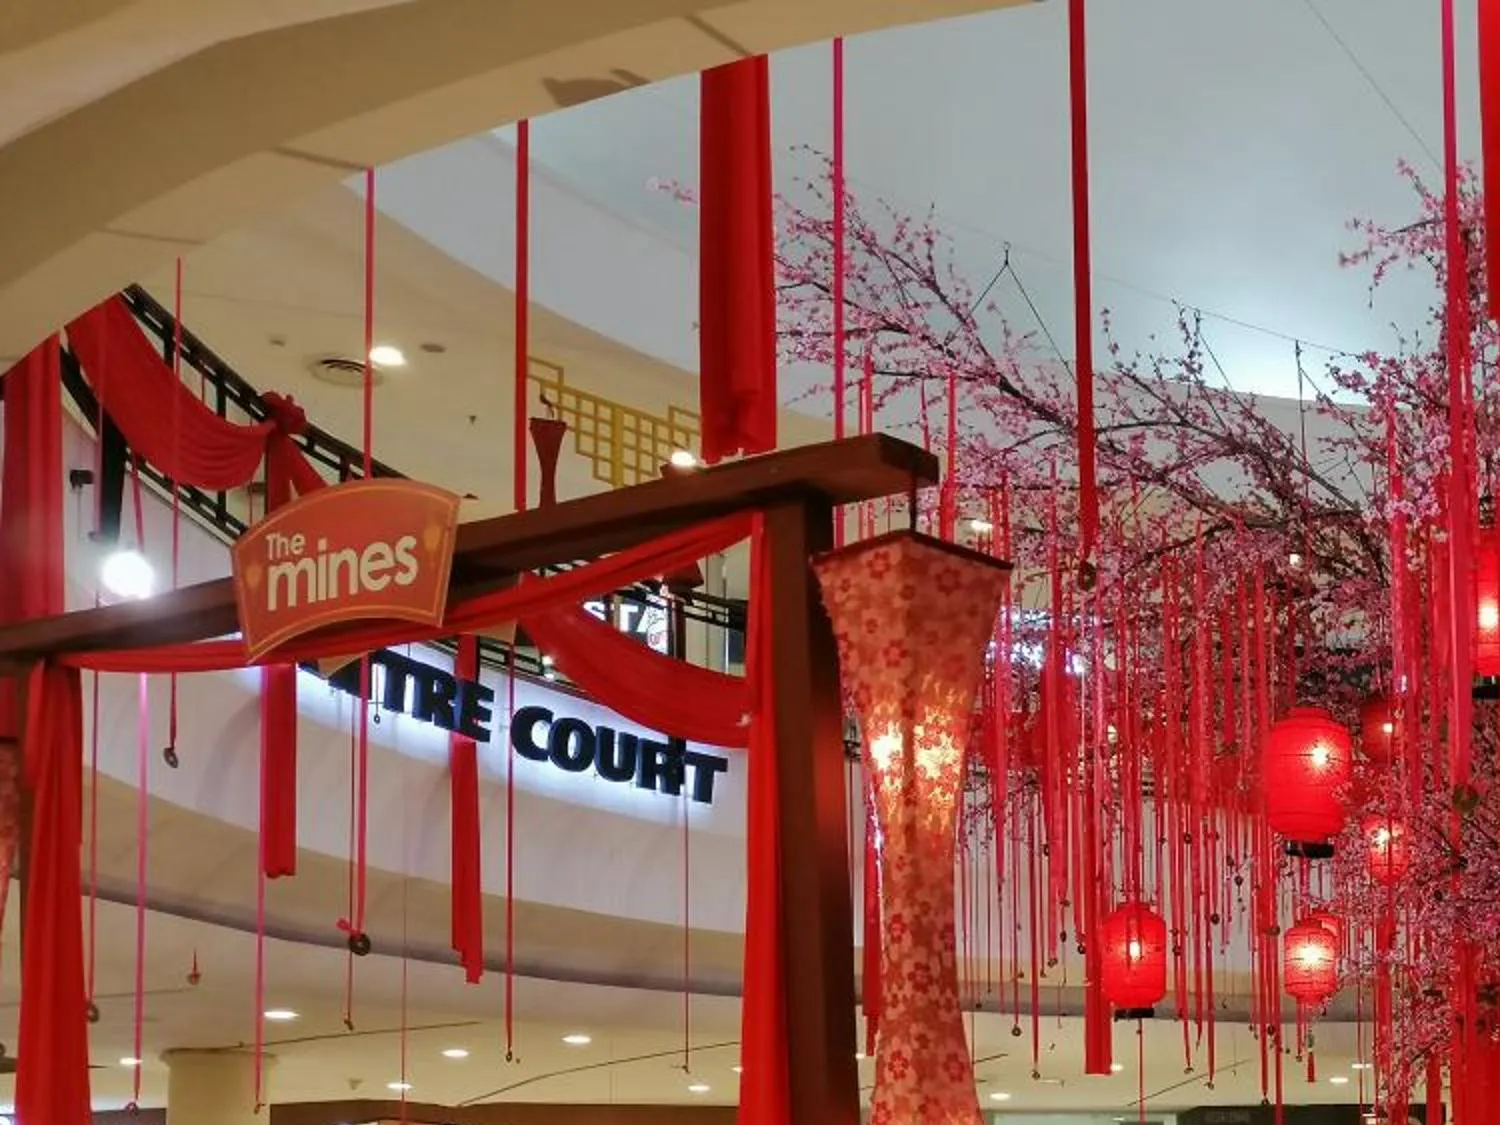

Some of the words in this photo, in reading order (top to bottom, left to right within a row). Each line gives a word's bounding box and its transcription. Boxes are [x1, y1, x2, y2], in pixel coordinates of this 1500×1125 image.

[266, 533, 306, 561] The
[267, 535, 418, 612] mines
[511, 704, 728, 804] COURT
